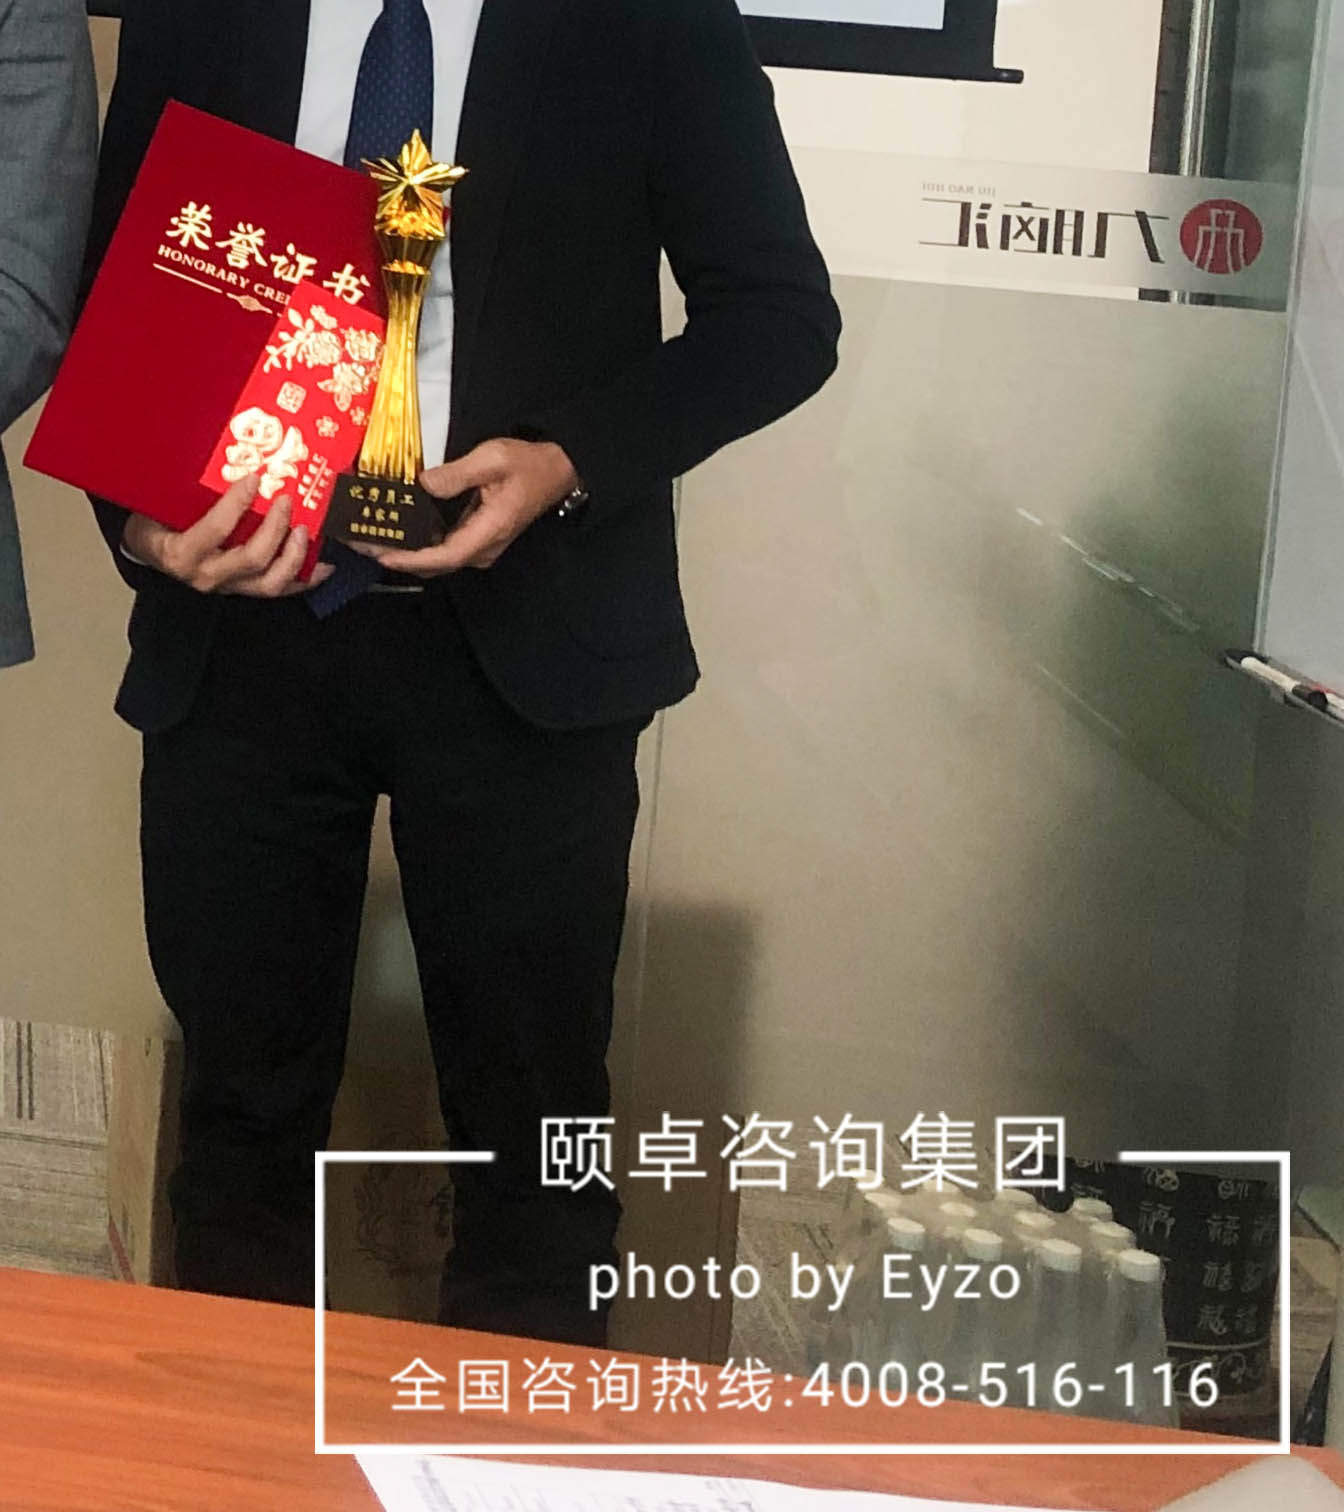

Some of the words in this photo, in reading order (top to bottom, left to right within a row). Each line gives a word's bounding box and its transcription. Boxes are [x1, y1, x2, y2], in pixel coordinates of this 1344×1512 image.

[157, 244, 251, 289] HONORARY
[165, 200, 371, 305] 荣誉证书
